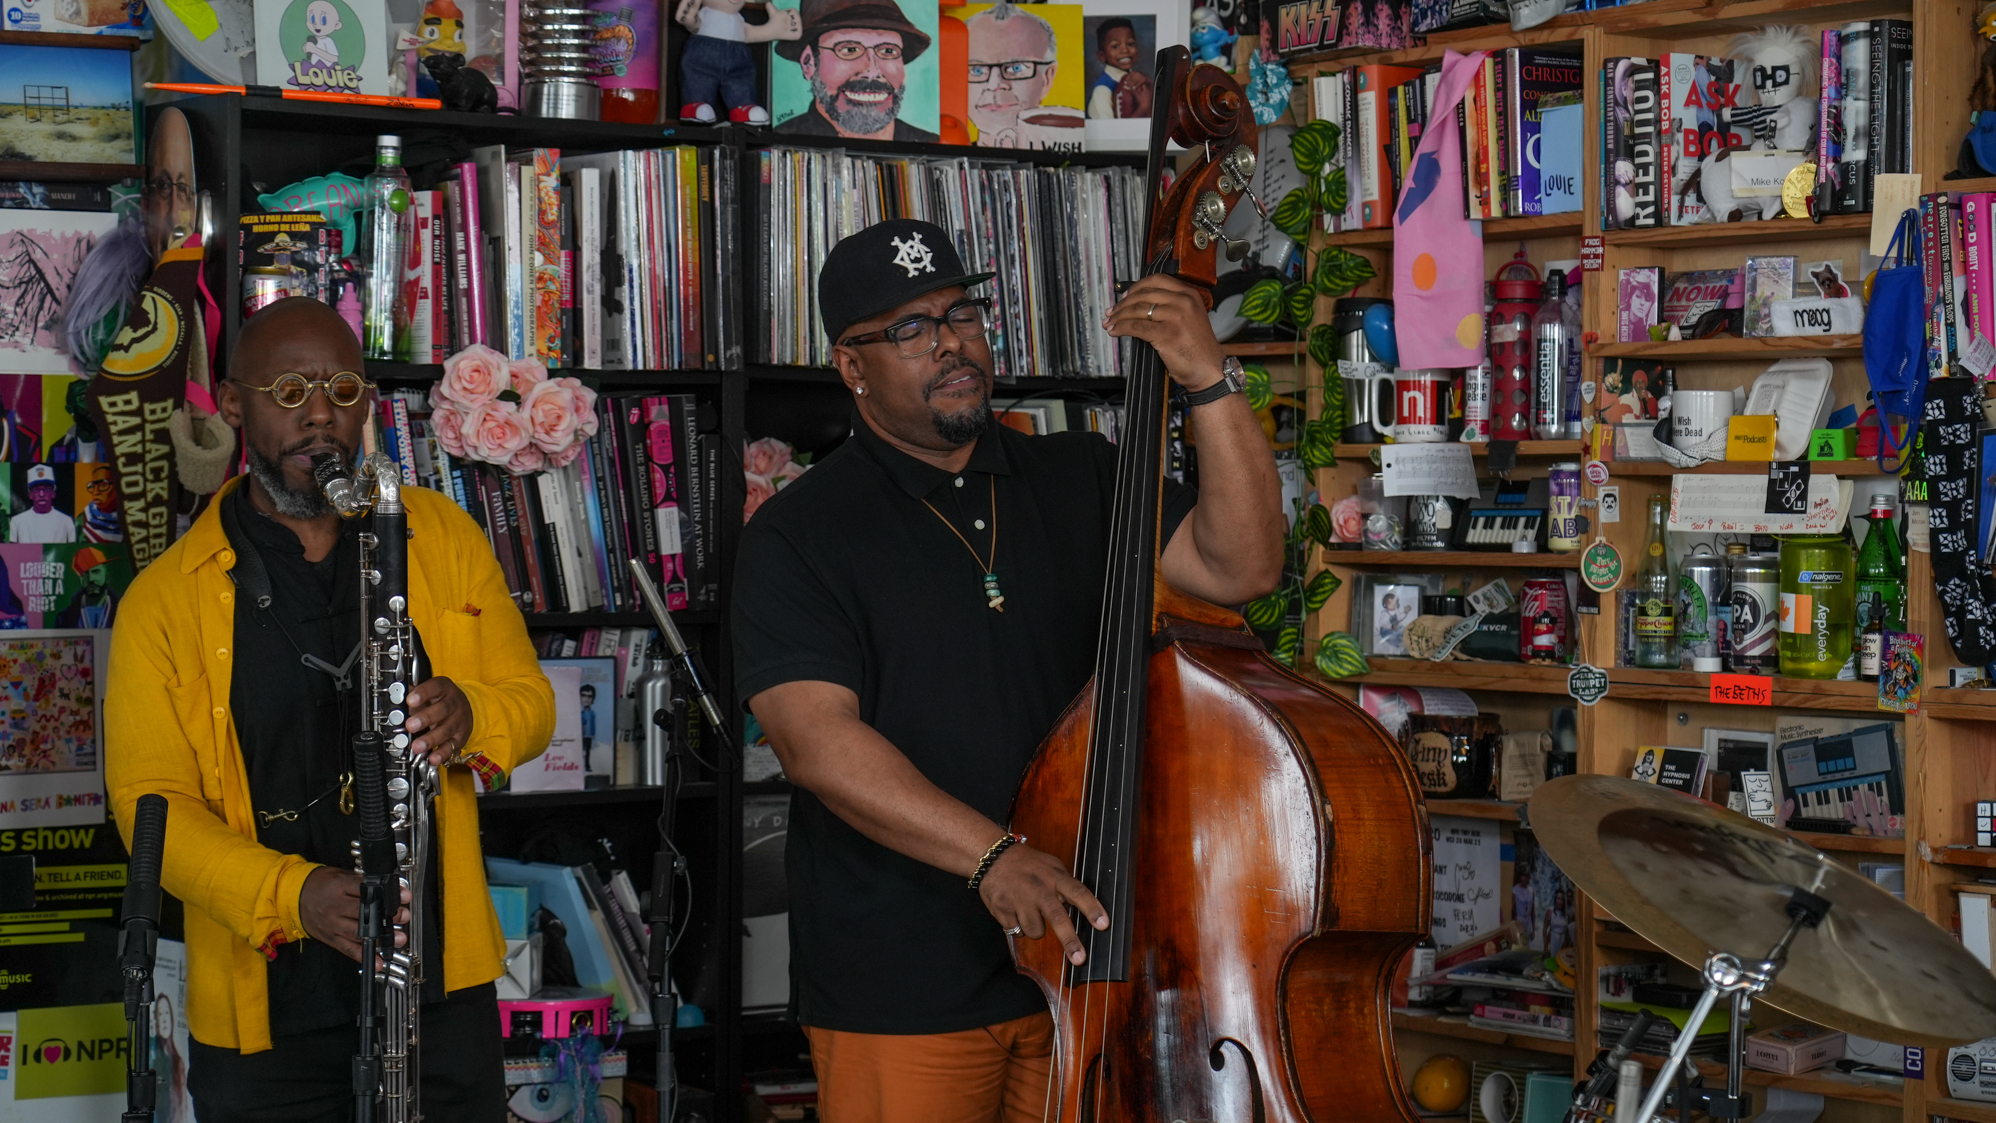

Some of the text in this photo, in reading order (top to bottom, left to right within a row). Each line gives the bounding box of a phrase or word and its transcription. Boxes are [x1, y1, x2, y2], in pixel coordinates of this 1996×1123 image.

[9, 11, 21, 20] 10
[1279, 0, 1341, 52] KISS
[1871, 37, 1881, 84] SEEING
[295, 61, 359, 90] Louie
[1661, 65, 1669, 93] ASK
[1606, 62, 1614, 149] MAN CONSTANT SORROW
[1683, 79, 1742, 111] ASK
[1661, 99, 1669, 130] BOB
[1820, 98, 1828, 131] CROSSROADS
[1870, 113, 1880, 151] LIGHT
[1041, 140, 1082, 153] WISH
[1544, 174, 1575, 197] LOUIE
[1634, 143, 1655, 227] REED
[1750, 177, 1771, 186] Mike
[240, 214, 281, 224] PIZZA Y PAN
[252, 224, 279, 233] HORNO
[279, 224, 291, 232] DE
[433, 219, 441, 263] OUR NOISE
[456, 231, 466, 251] HANK
[1966, 201, 1980, 313] GOOD BOOTY ANN
[457, 253, 468, 289] WILLIAMS
[1667, 284, 1725, 303] NOW
[528, 287, 536, 347] PHOTOGRAPHS
[1539, 341, 1550, 402] essentia
[1403, 390, 1424, 417] n
[1678, 416, 1692, 426] Wish
[1684, 427, 1703, 437] Dead
[96, 390, 144, 495] BANJO
[392, 401, 408, 466] HISTORY
[1743, 434, 1767, 443] Podcasts
[144, 398, 174, 502] BLACK
[501, 475, 518, 527] JAZZ LIVES
[686, 416, 705, 570] LEONARD BERNSTEIN AT WORK
[1905, 480, 1928, 501] AAA
[511, 479, 529, 536] kansas city
[635, 442, 656, 564] THE ROLLING STONES 50
[20, 561, 65, 579] LOUDER
[21, 578, 64, 596] THAN A
[28, 595, 58, 613] RIOT
[1482, 624, 1508, 632] KVCR
[1813, 601, 1830, 662] everyday
[1571, 678, 1606, 689] TRUMPET
[1714, 684, 1767, 704] THE BETHS
[1779, 723, 1804, 735] Electronic
[1780, 727, 1824, 741] Music Synthesizer
[543, 753, 564, 763] Lee
[1410, 736, 1448, 769] Tiny
[543, 761, 579, 773] Fields
[1662, 771, 1691, 779] HYPNOSIS
[1661, 778, 1684, 786] CENTER
[21, 825, 95, 851] show
[49, 870, 124, 884] TELL A FRIEND.
[22, 1043, 28, 1066] I
